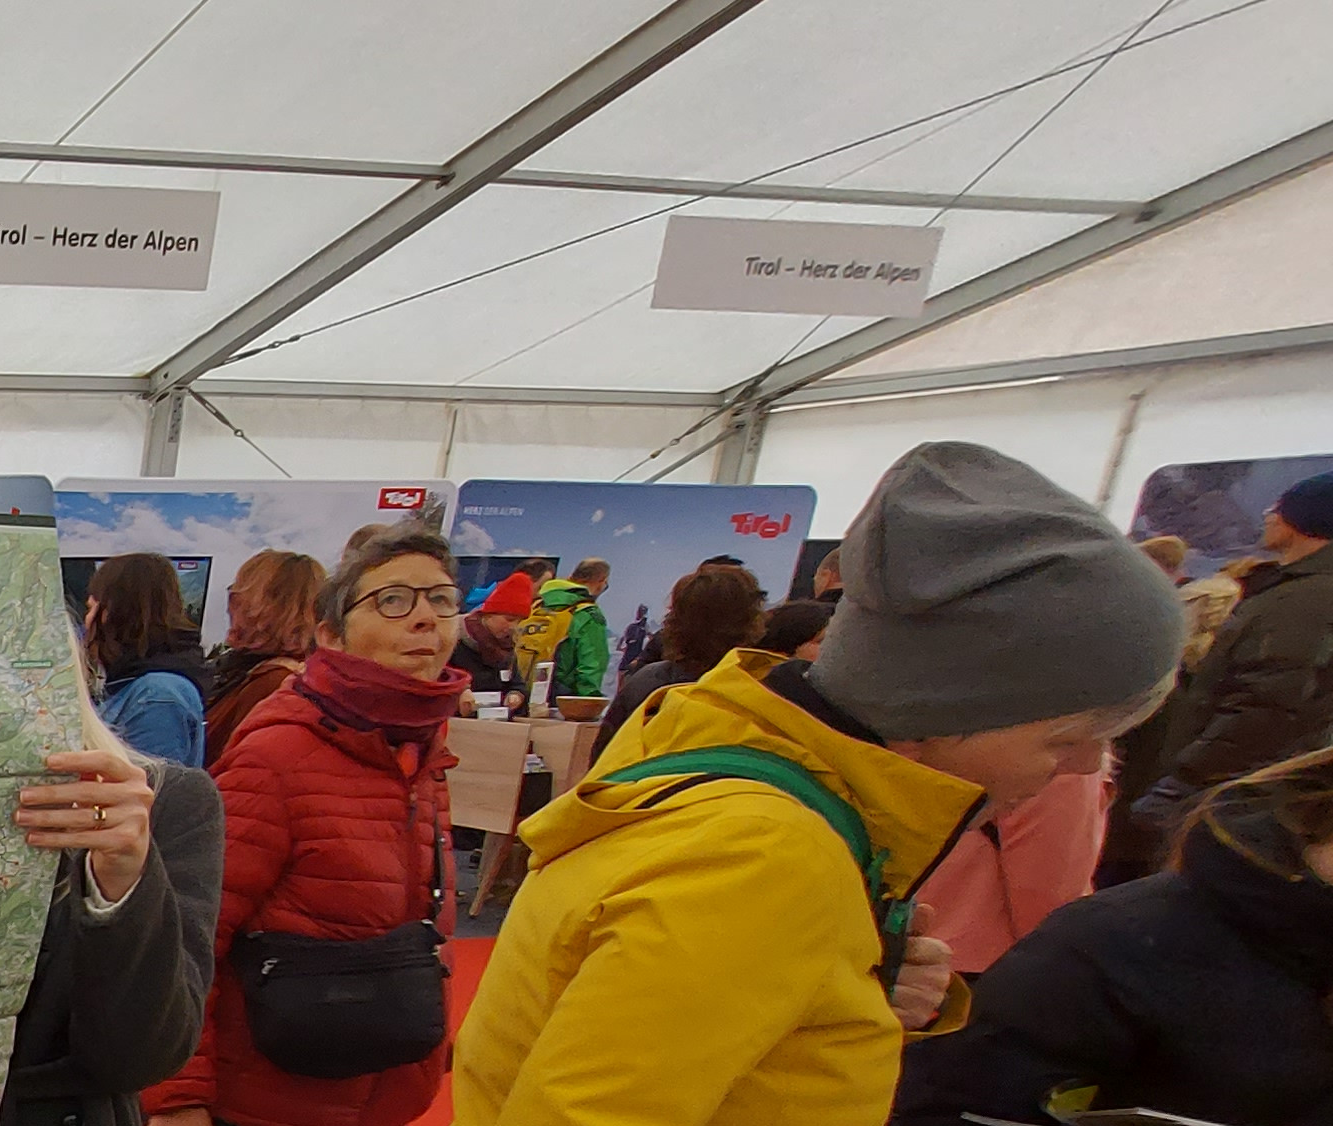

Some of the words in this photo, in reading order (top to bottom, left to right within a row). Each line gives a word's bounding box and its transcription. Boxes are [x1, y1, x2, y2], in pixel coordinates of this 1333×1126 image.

[52, 227, 99, 248] Herz
[104, 228, 139, 249] der
[143, 230, 199, 256] Alpen
[745, 256, 782, 276] Tirol
[799, 259, 841, 279] Herz
[842, 261, 872, 279] der
[873, 262, 921, 285] Alpen
[730, 512, 792, 539] Tirol
